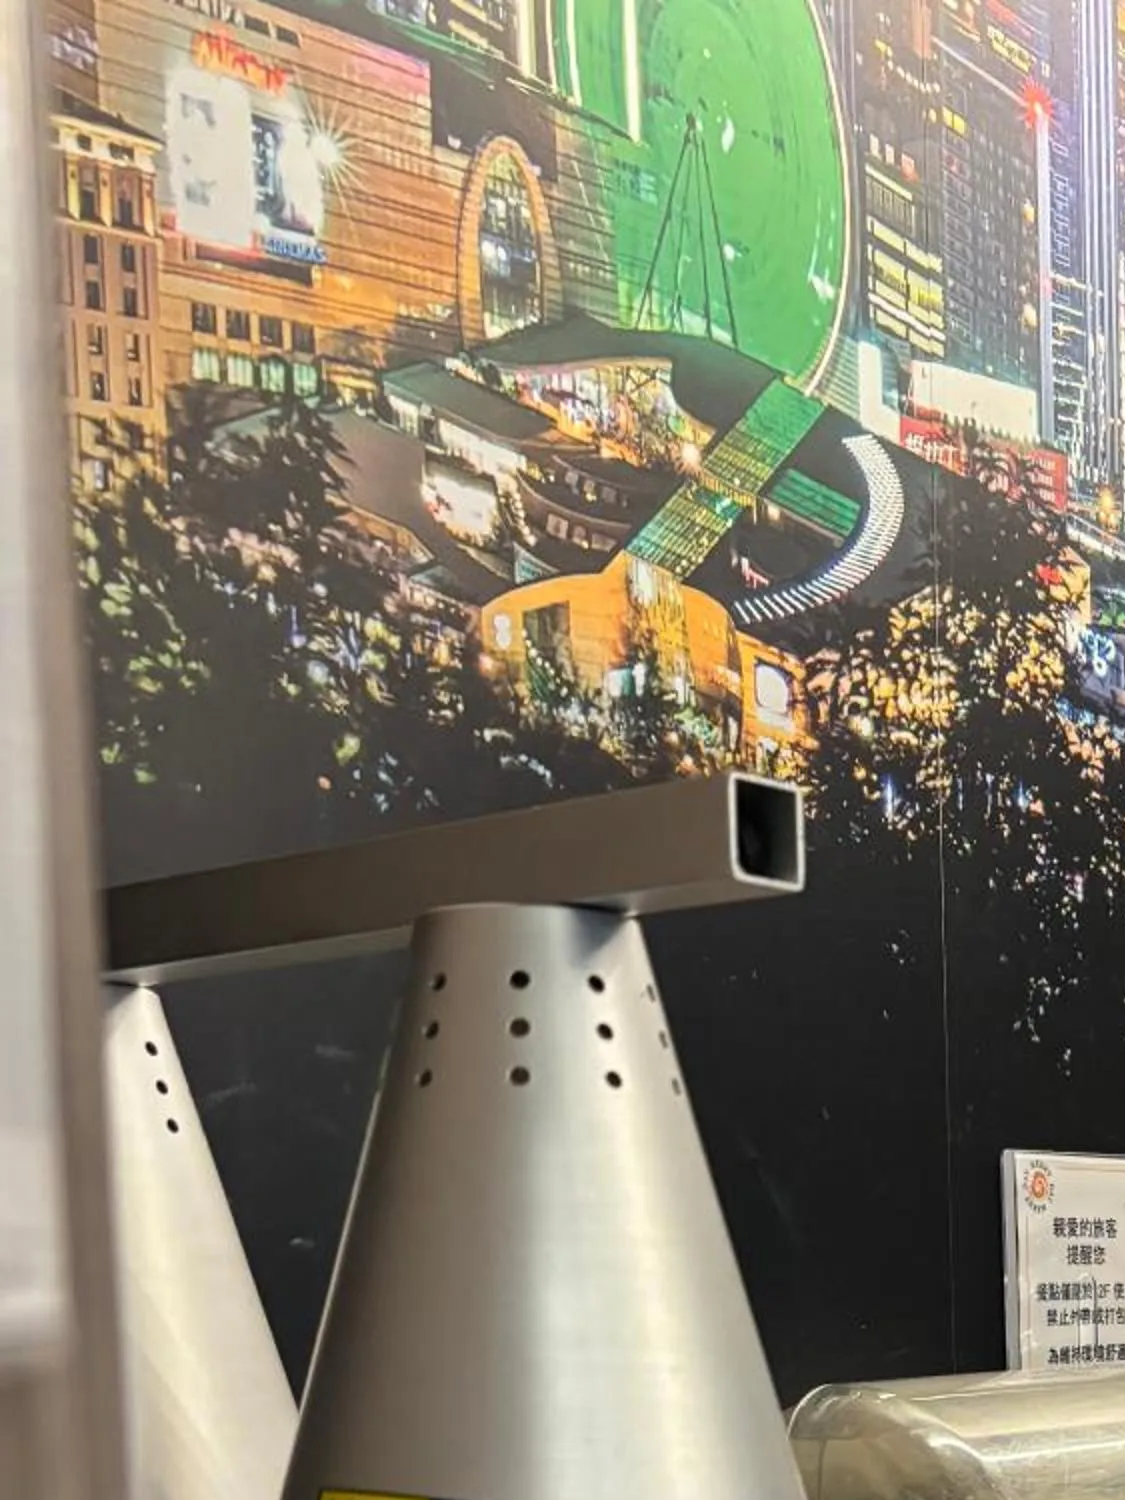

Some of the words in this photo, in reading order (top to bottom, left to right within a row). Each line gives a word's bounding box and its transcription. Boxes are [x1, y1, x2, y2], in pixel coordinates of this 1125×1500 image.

[1053, 1217, 1117, 1238] 親愛的旅客
[1067, 1244, 1106, 1265] 提醒您
